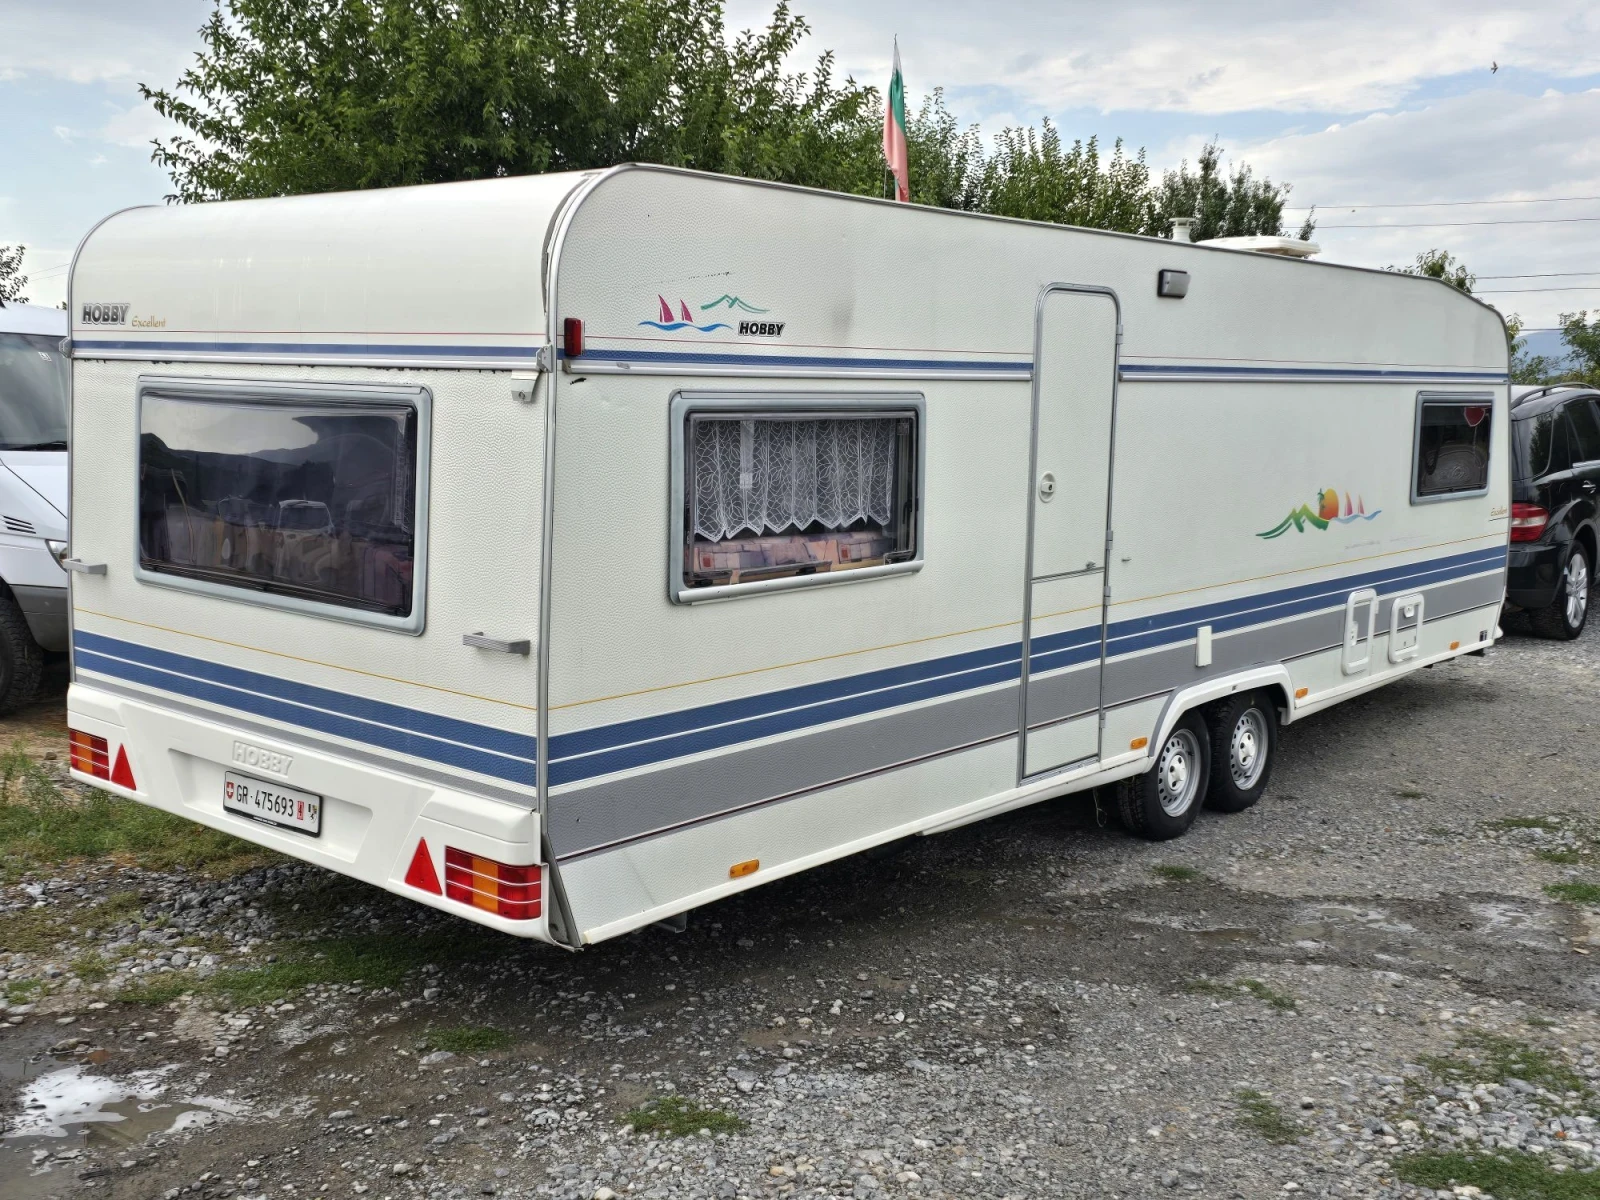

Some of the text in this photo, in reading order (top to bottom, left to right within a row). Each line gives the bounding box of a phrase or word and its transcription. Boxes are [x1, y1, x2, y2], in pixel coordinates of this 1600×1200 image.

[82, 304, 166, 328] HOBBY Excellent
[738, 321, 785, 337] HOBBY
[233, 741, 293, 777] HOBBY
